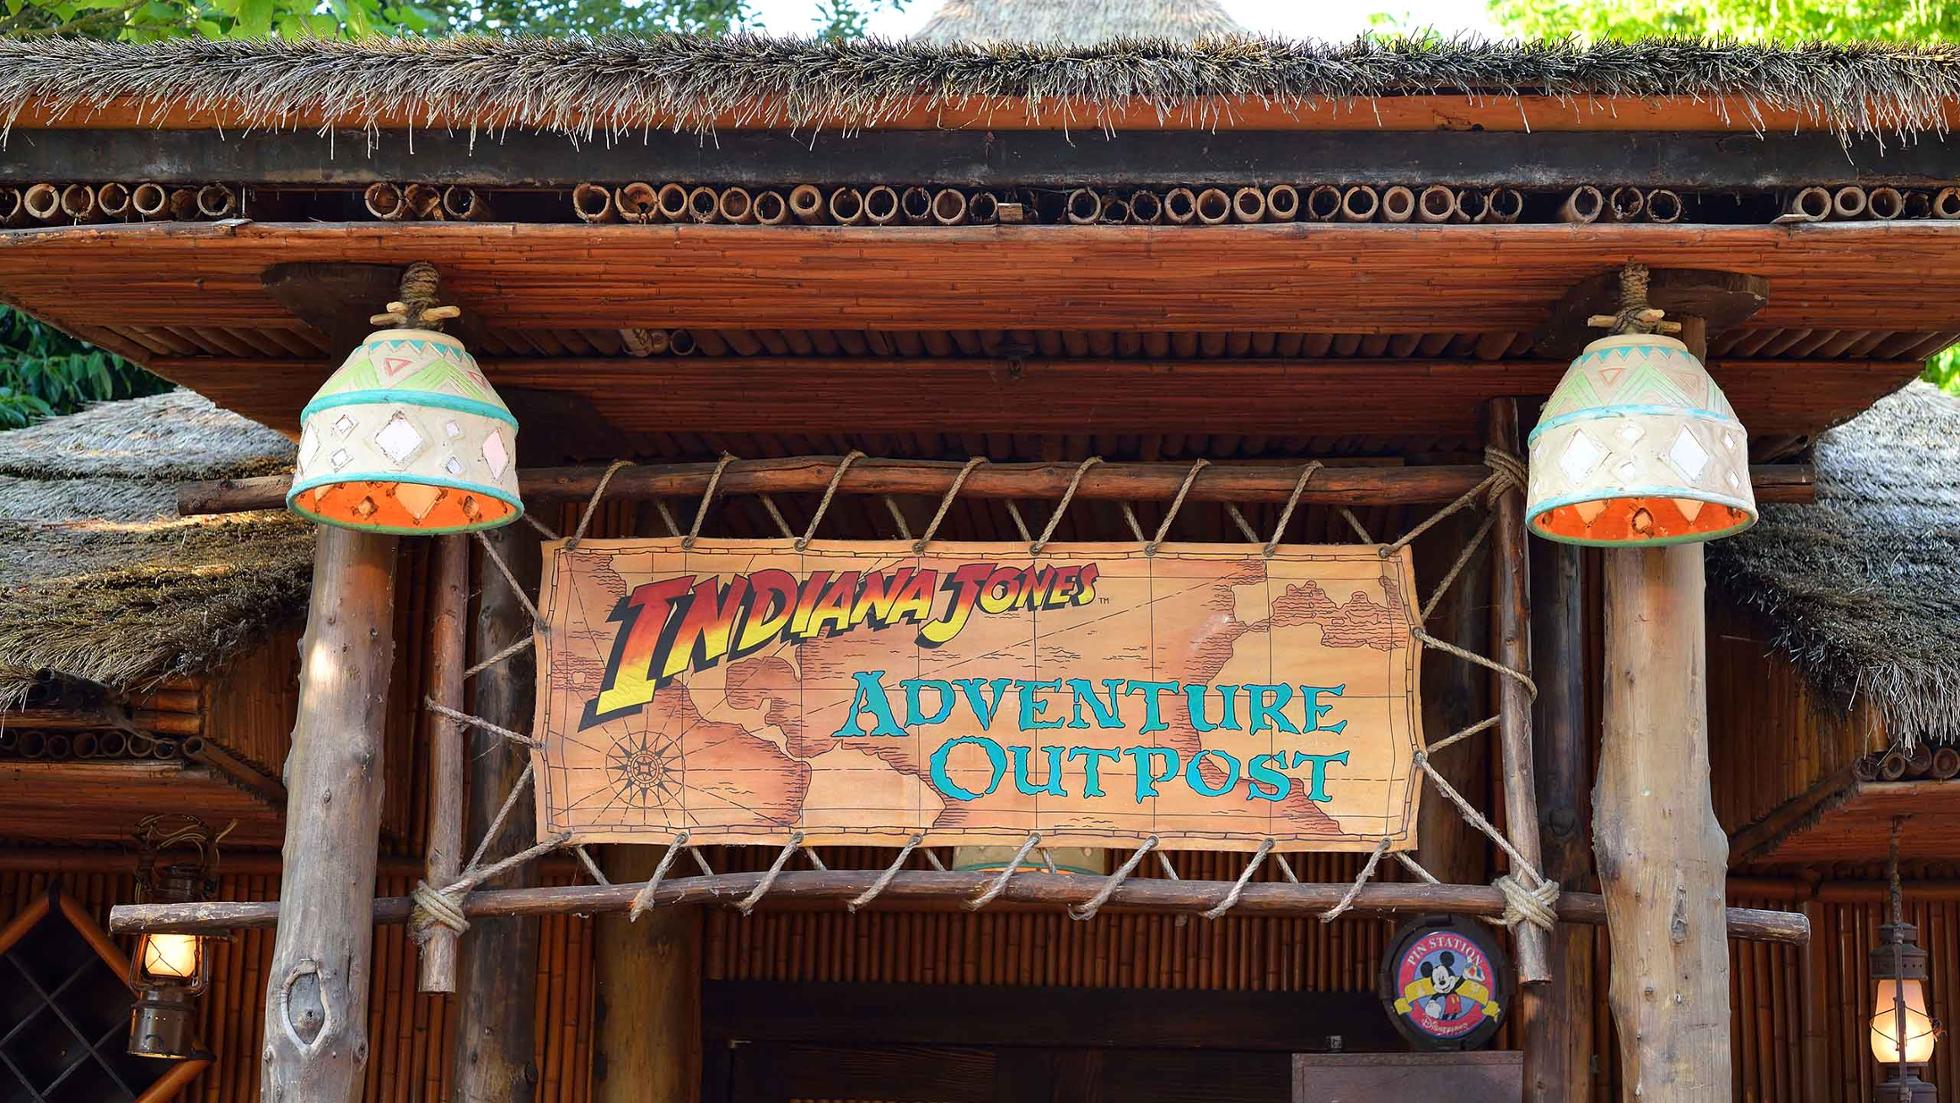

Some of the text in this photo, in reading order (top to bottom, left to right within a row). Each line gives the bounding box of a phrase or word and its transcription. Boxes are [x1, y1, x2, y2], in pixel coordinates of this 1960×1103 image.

[579, 567, 938, 732] INDIANA
[915, 562, 1100, 649] JONES
[831, 670, 1348, 736] ADVENTURE
[929, 735, 1350, 804] OUTPOST
[1407, 936, 1483, 967] PIN STATION
